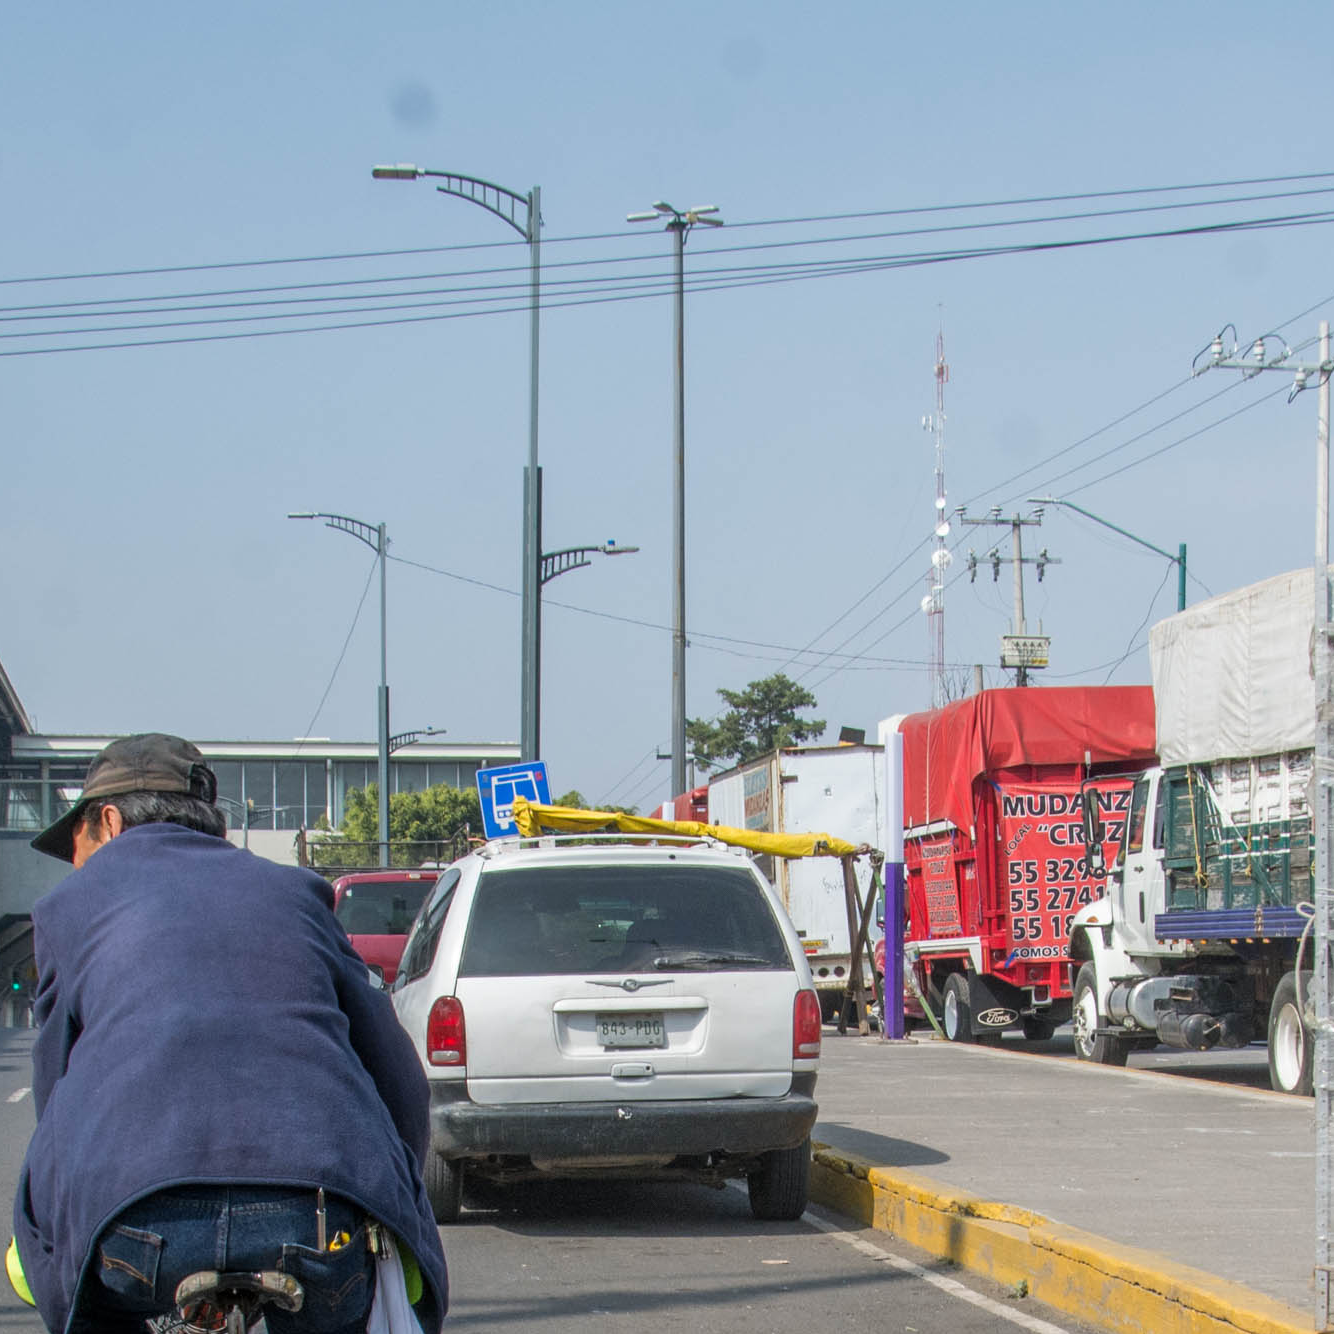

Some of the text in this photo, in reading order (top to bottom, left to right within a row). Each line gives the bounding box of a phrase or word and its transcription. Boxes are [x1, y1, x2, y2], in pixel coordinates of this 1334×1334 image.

[1004, 823, 1033, 857] LOCAL
[1008, 860, 1039, 885] 55
[1011, 888, 1040, 913] 55
[1013, 917, 1042, 941] 55
[987, 1010, 1011, 1023] Ford
